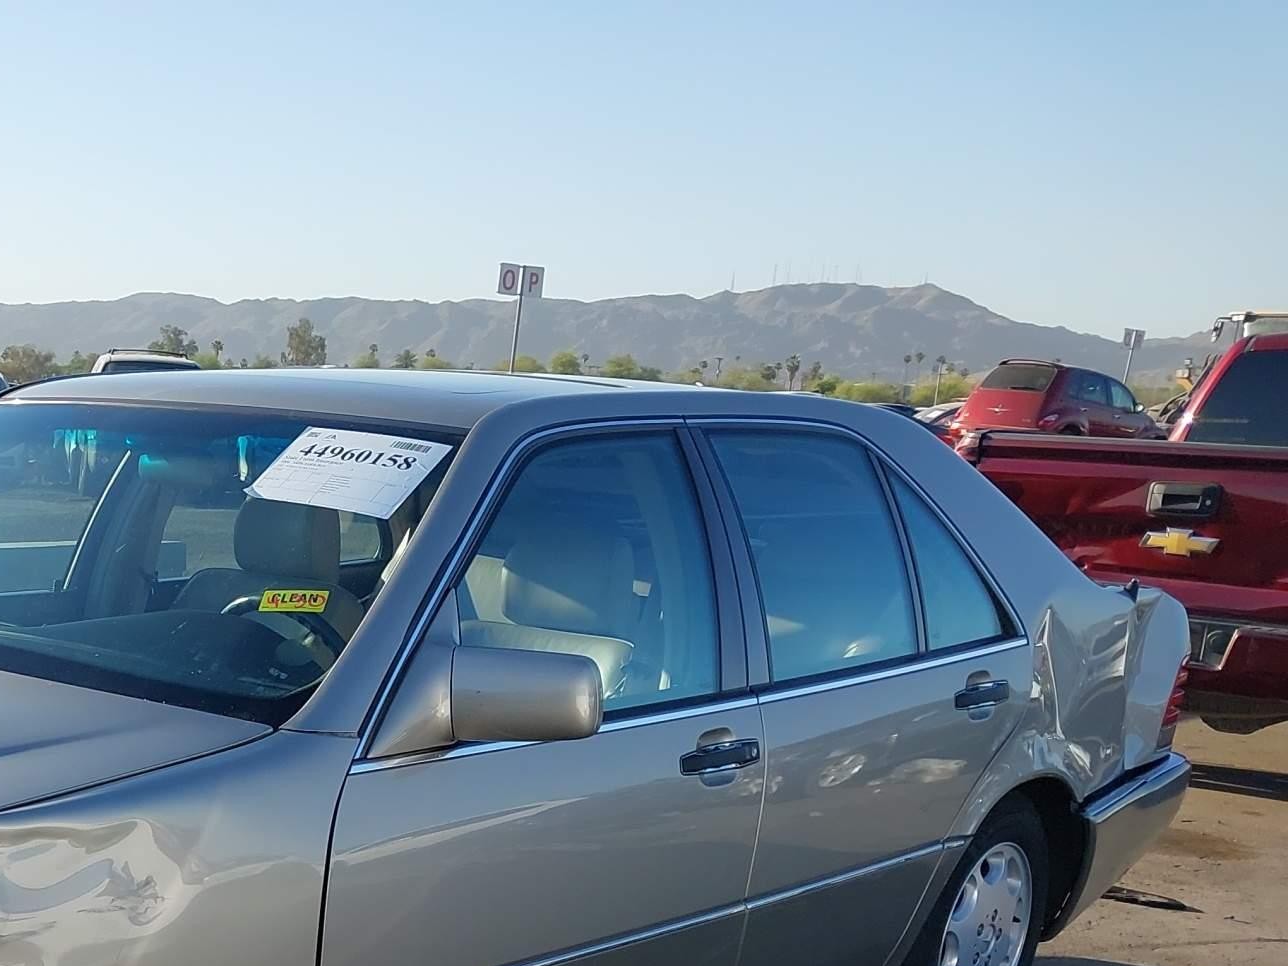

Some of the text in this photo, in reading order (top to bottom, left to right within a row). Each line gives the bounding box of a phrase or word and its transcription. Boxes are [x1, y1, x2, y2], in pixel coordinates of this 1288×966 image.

[528, 271, 539, 293] P
[300, 443, 417, 471] 44960158
[271, 593, 319, 603] CLEAN
